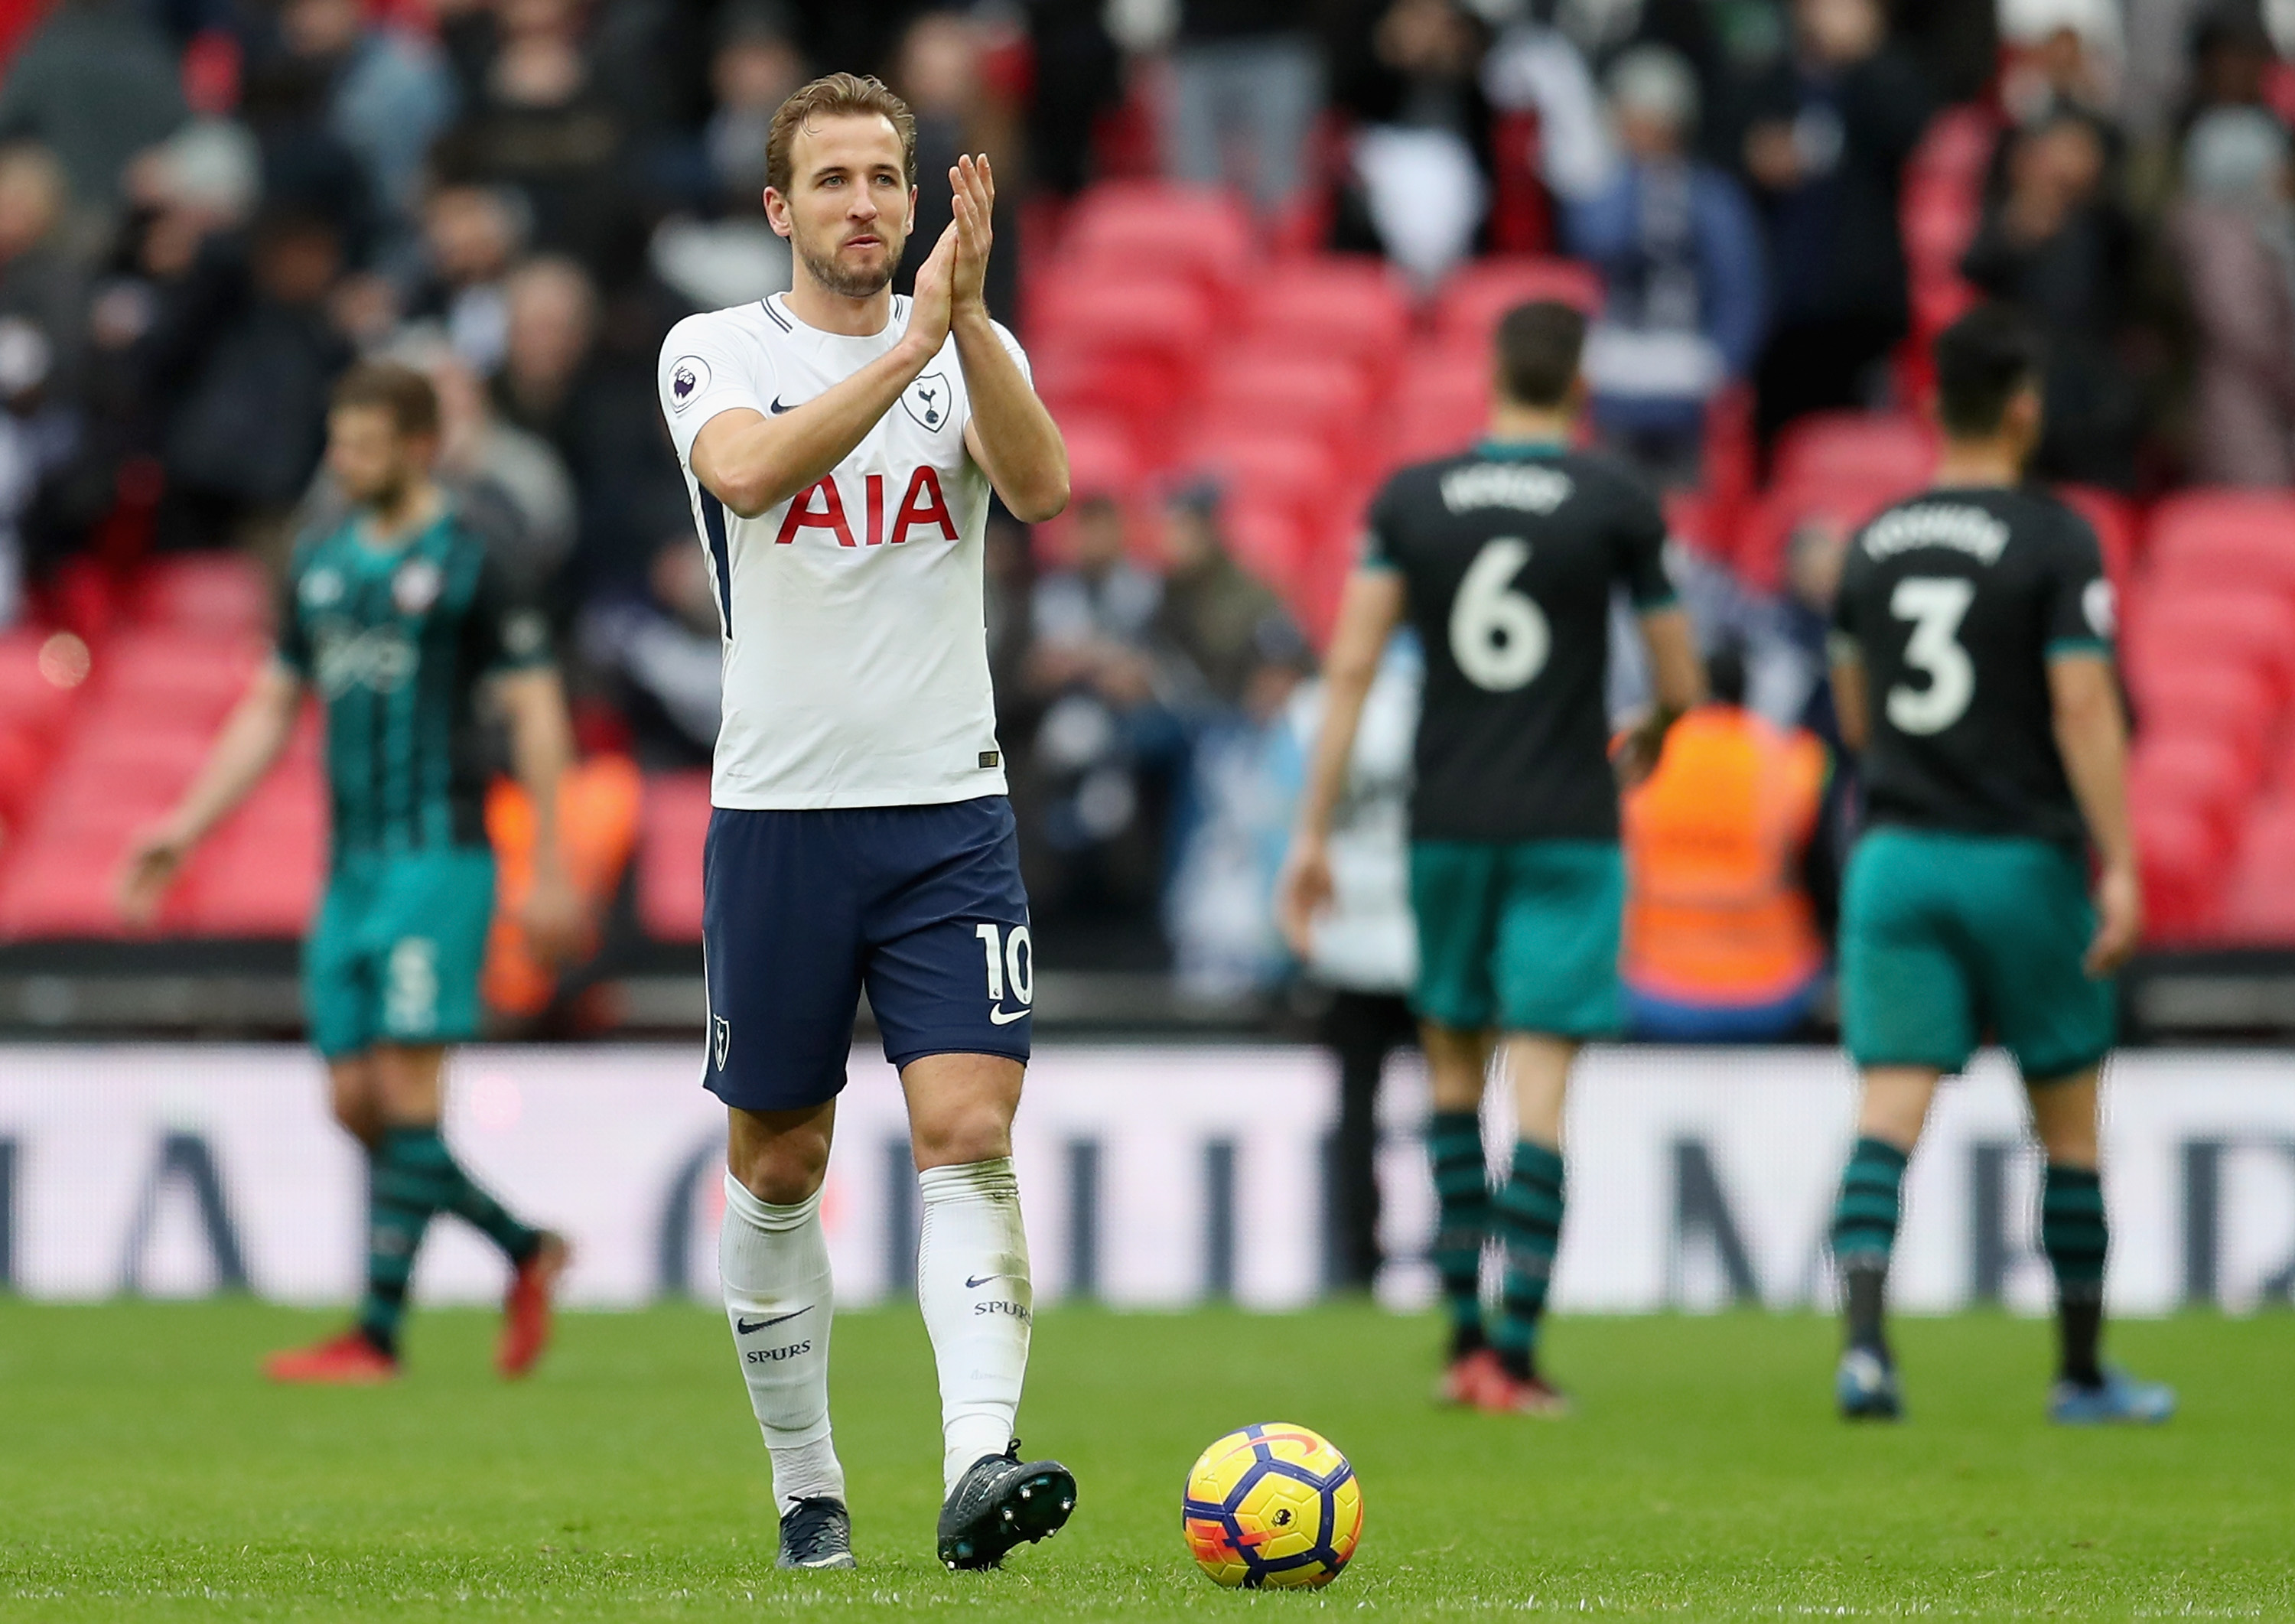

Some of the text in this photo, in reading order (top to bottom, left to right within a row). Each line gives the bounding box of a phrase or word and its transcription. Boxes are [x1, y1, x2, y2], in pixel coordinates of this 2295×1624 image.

[774, 464, 960, 547] AIA
[1449, 535, 1553, 693] 6
[1886, 575, 1977, 736] 3
[975, 923, 1034, 1005] 10
[747, 1339, 812, 1364] SPURS
